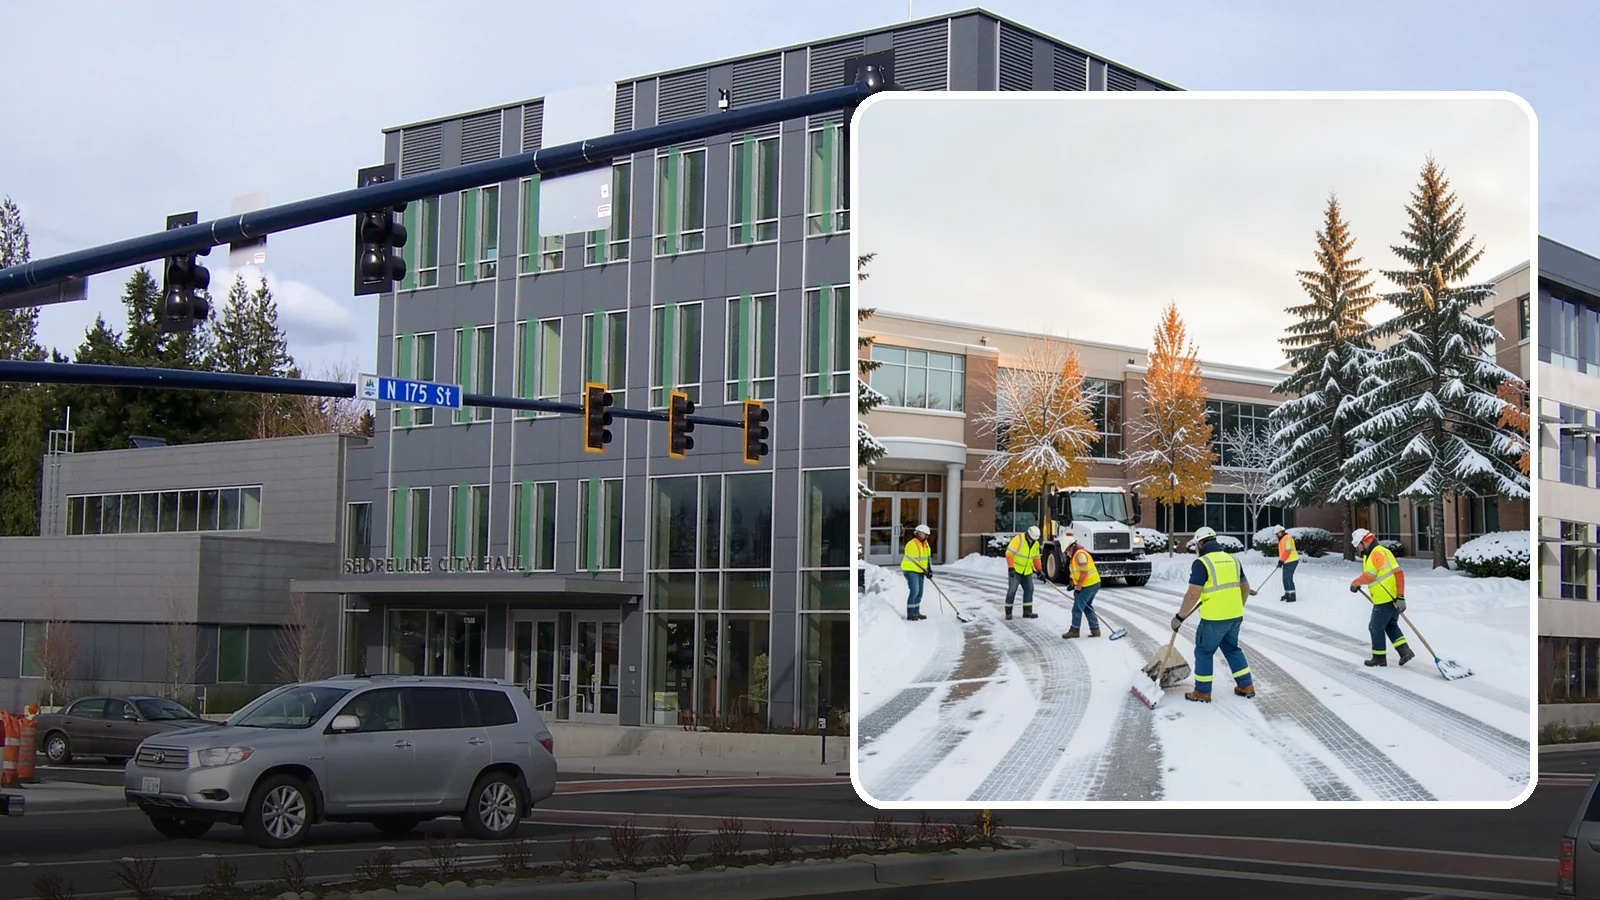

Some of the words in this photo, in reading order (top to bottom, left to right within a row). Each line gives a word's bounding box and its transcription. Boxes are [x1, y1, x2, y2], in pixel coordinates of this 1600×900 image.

[387, 380, 396, 400] N
[405, 382, 427, 403] 175
[436, 386, 451, 406] St
[344, 557, 431, 574] SHORELINE
[438, 556, 475, 572] CITY
[483, 555, 526, 572] HALL
